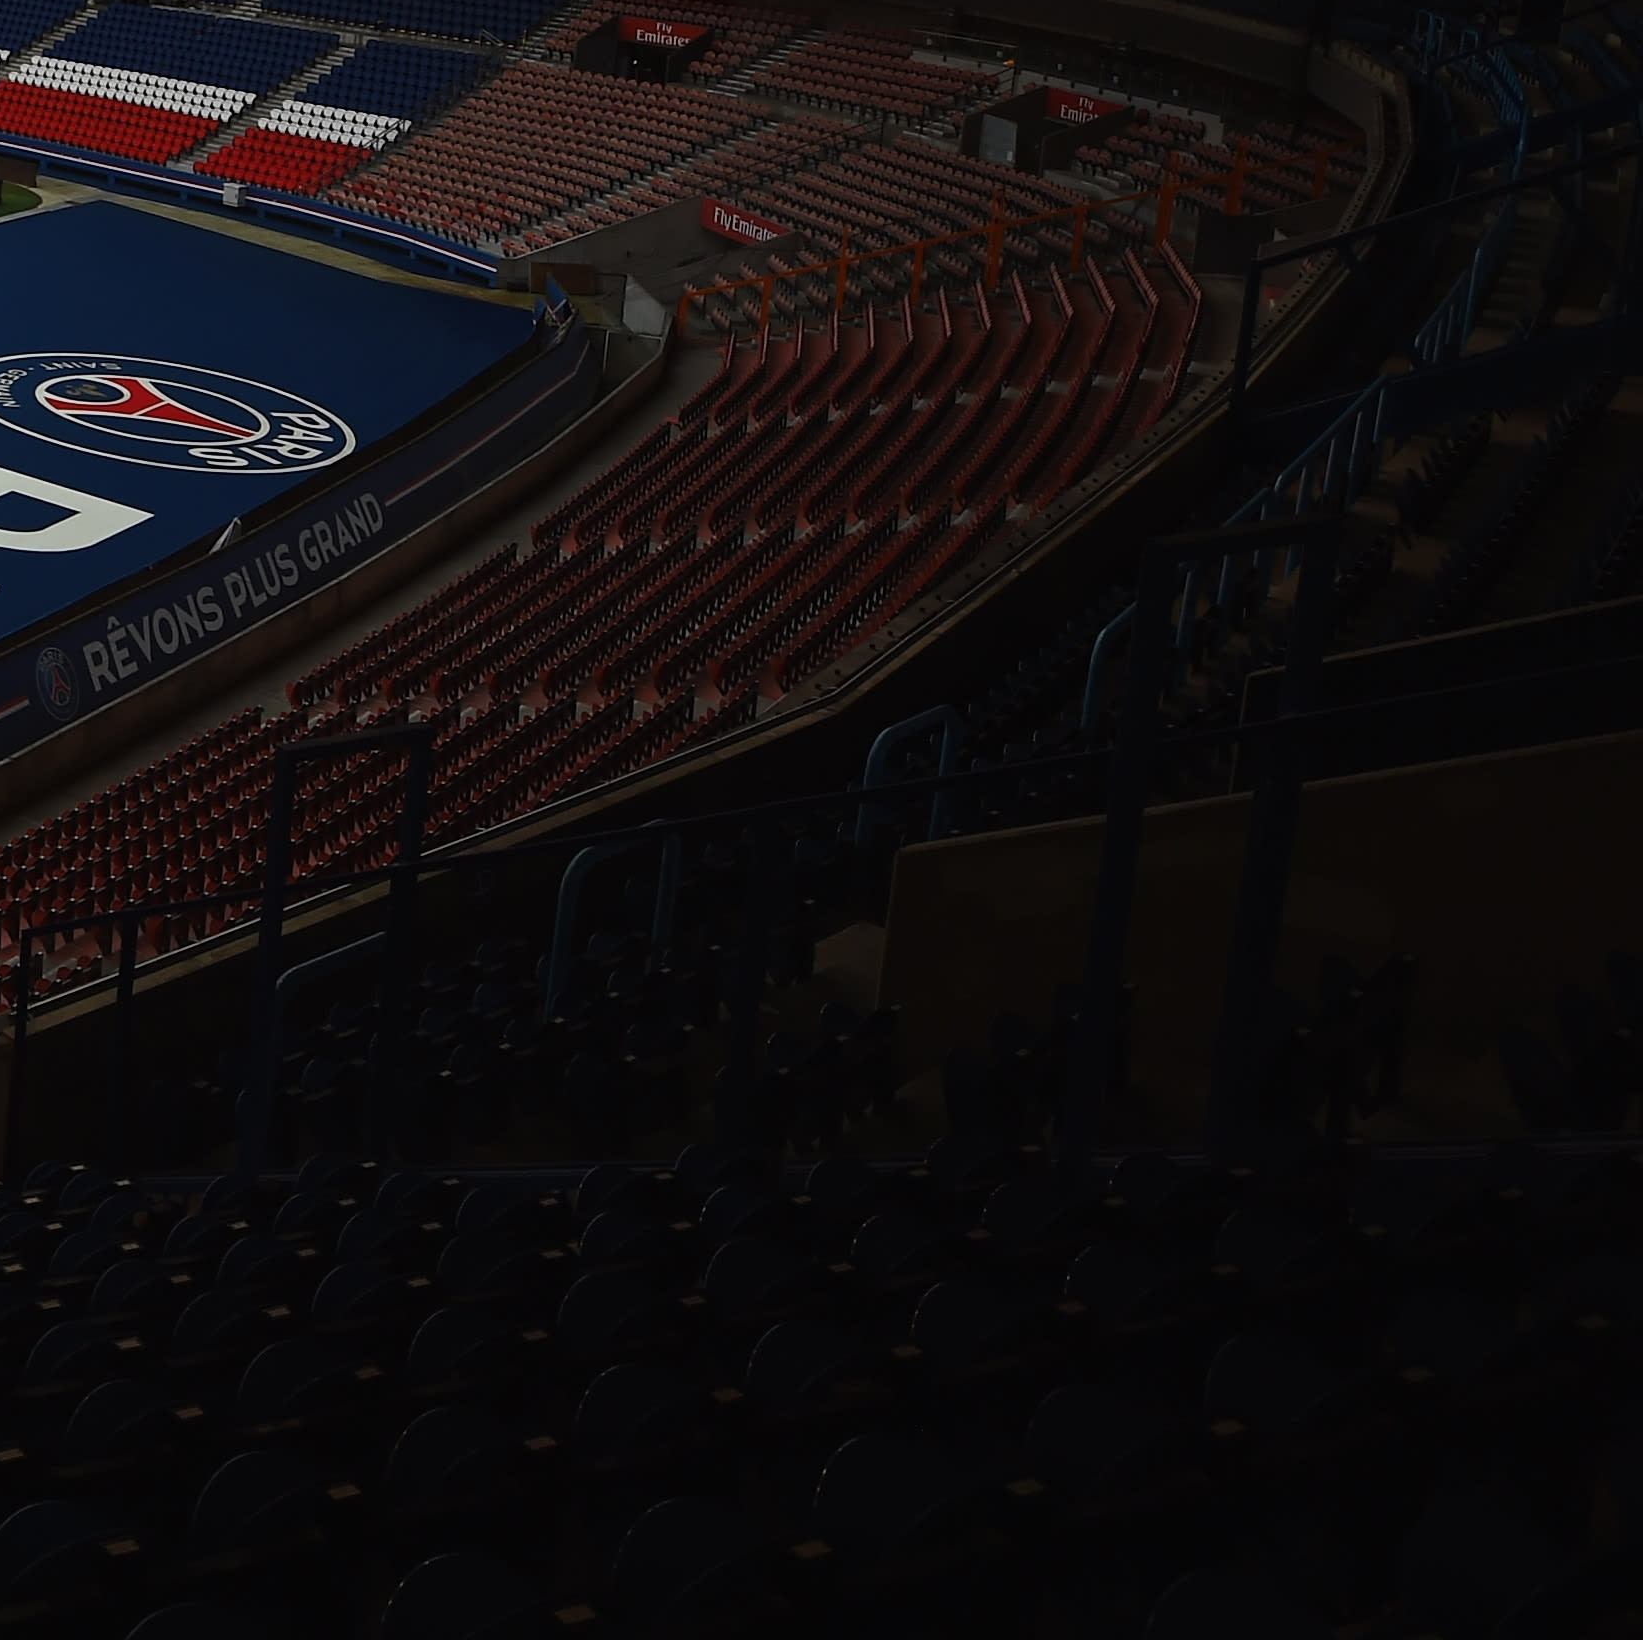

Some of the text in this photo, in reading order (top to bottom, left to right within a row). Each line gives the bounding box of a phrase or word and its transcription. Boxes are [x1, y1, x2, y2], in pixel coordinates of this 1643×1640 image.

[657, 22, 673, 34] Fly
[713, 207, 780, 242] Fly Emirate
[187, 411, 334, 466] PARIS
[82, 491, 385, 692] RÊVONS PLUS GRAND
